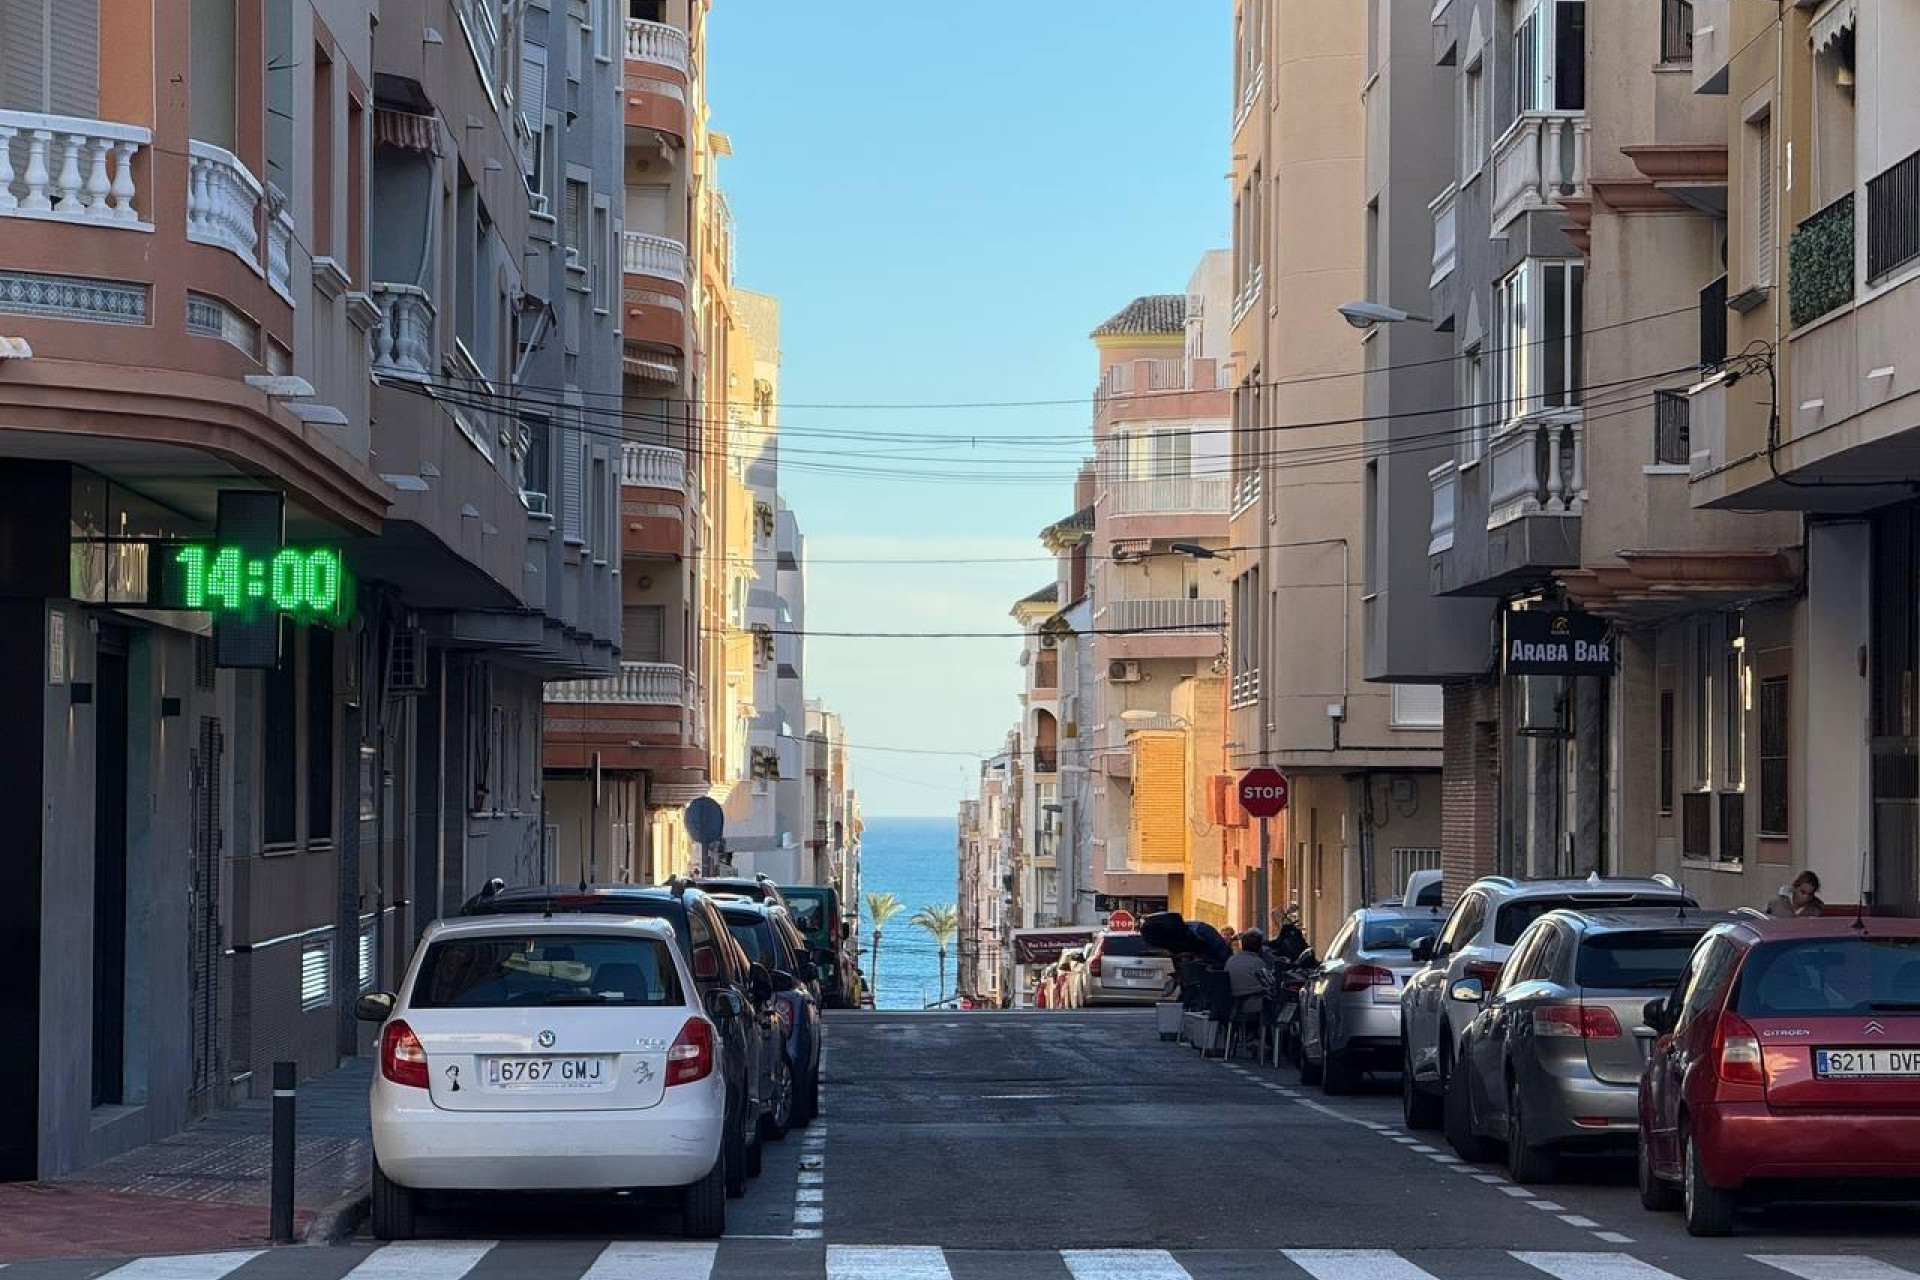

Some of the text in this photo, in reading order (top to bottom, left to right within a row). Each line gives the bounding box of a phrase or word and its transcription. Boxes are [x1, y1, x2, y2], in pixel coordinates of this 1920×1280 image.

[175, 547, 337, 609] 14:00
[1511, 639, 1610, 662] ARABA BAR
[1243, 786, 1285, 799] STOP
[1109, 920, 1134, 928] STOP
[501, 1060, 601, 1081] 6767 GMJ
[1831, 1053, 1876, 1071] 6211
